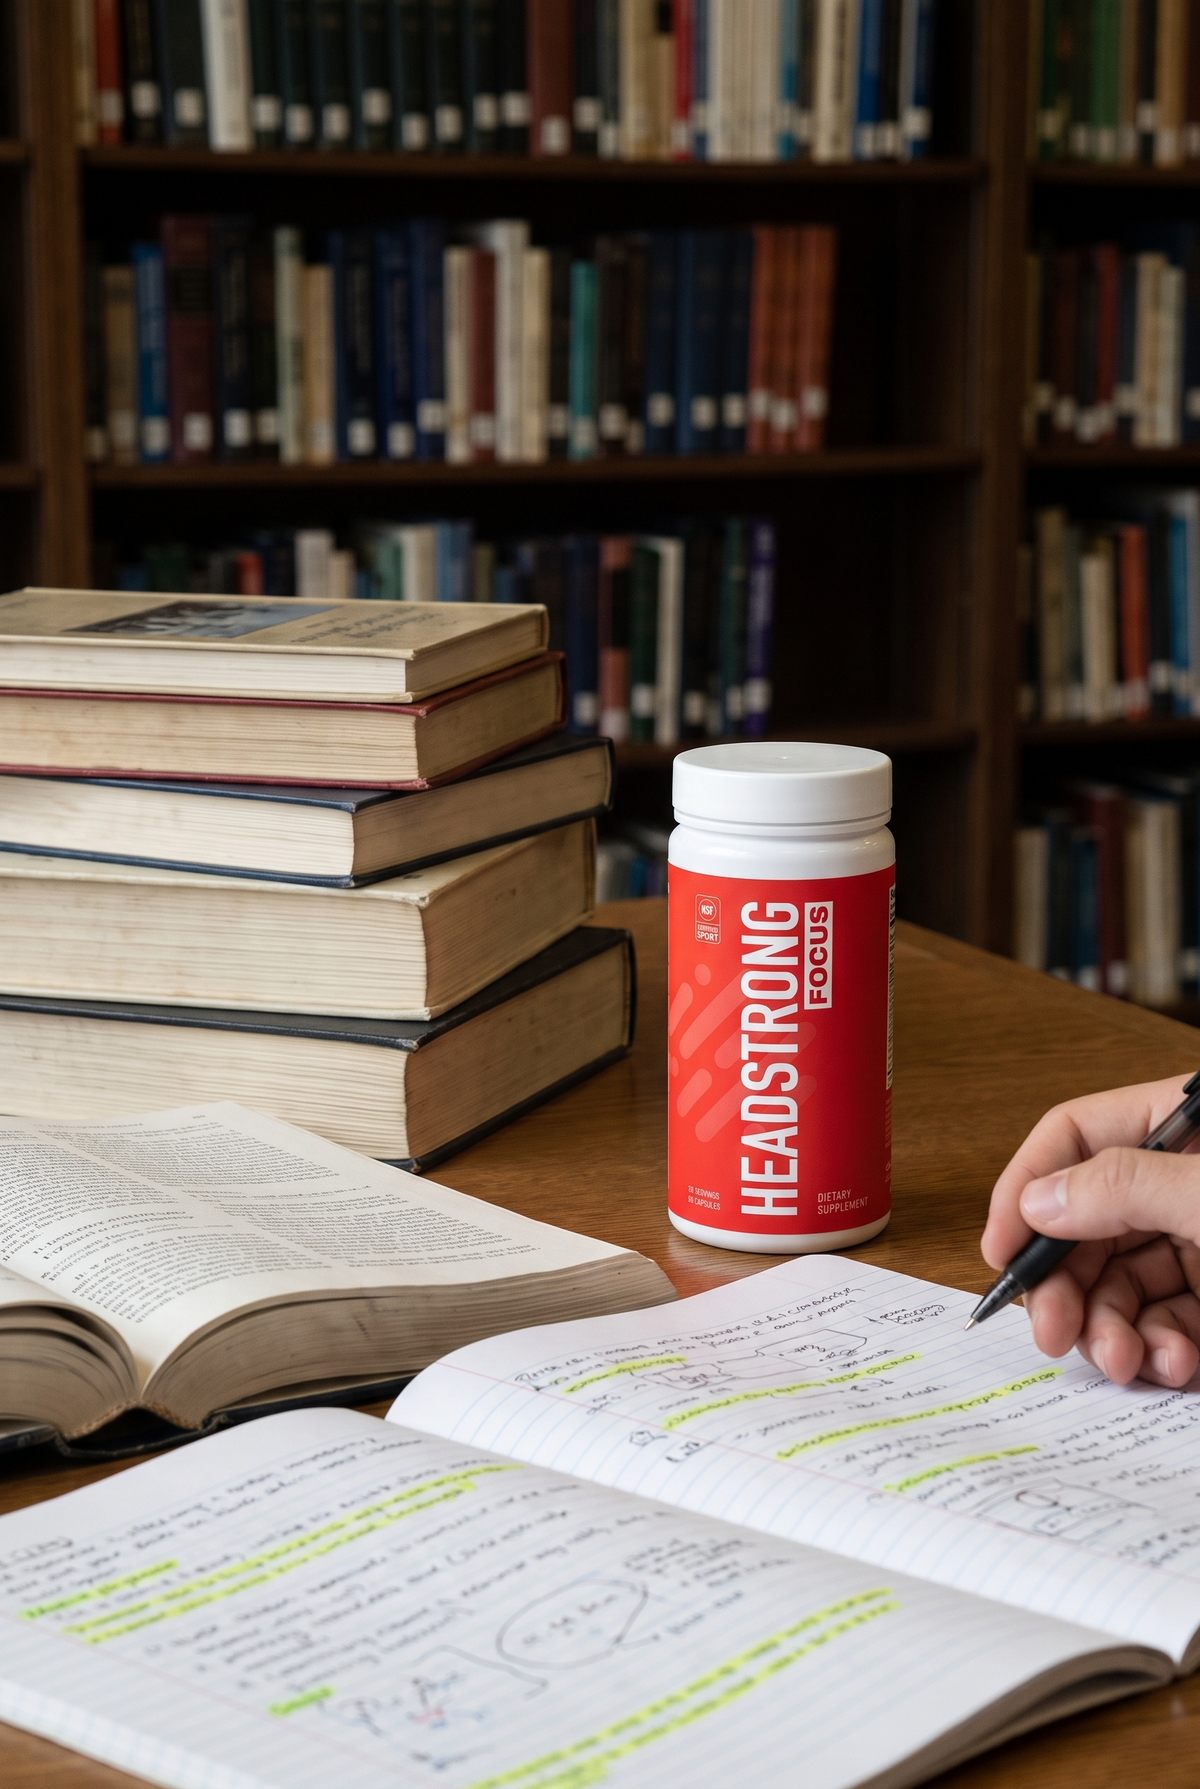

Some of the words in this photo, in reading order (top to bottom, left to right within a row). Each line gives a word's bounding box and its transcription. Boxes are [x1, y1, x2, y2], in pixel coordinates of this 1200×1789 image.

[701, 904, 714, 916] NSF
[697, 930, 719, 942] SPORT
[808, 905, 829, 1005] FOCUS
[740, 901, 800, 1216] HEADSTRONG
[817, 1189, 852, 1203] DIETARY
[694, 1197, 721, 1210] CAPSULES
[817, 1196, 869, 1215] SUPPLEMENT
